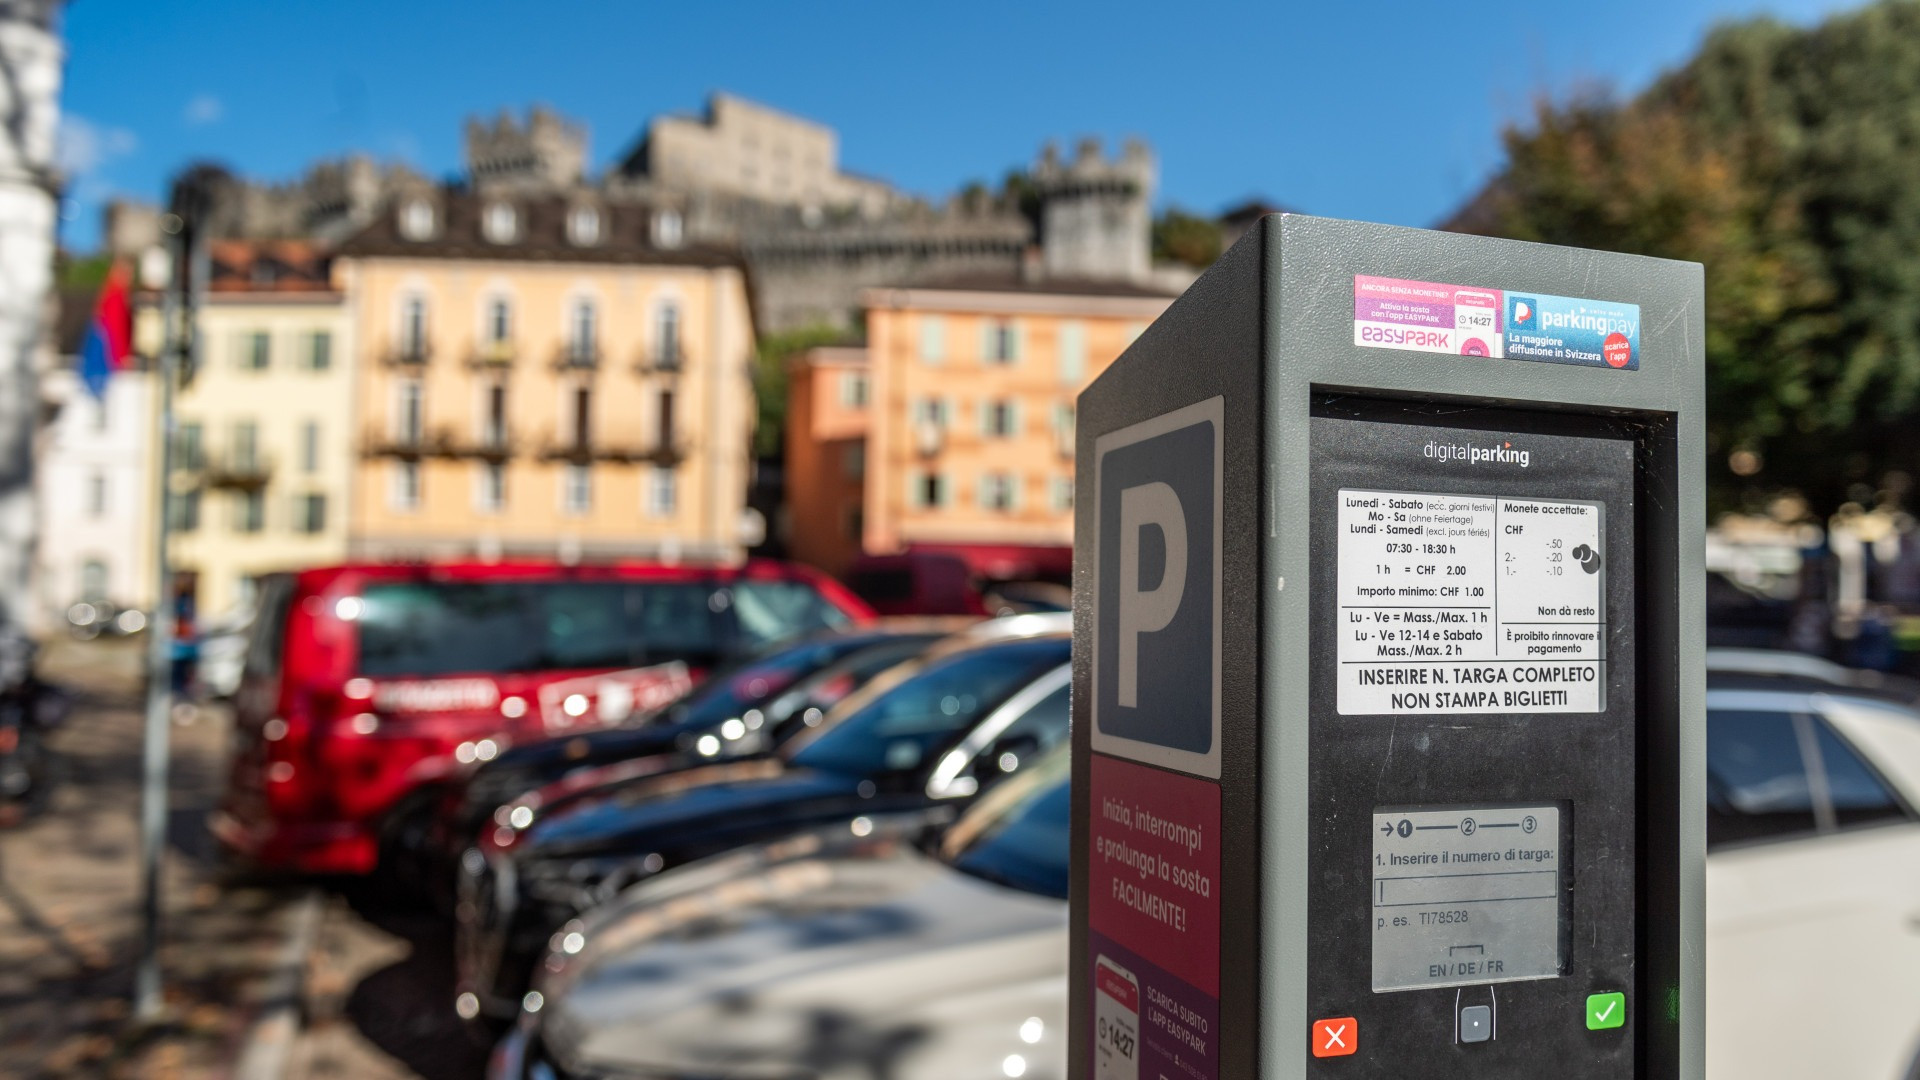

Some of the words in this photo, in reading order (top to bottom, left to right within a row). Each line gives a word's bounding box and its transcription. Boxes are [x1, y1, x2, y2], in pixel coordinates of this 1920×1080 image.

[1361, 284, 1390, 292] ANCORA
[1391, 286, 1412, 294] SENZA
[1380, 302, 1402, 311] Attiva
[1402, 304, 1410, 312] la
[1410, 306, 1430, 314] sosta
[1404, 314, 1440, 322] EASYPARK
[1468, 316, 1492, 326] 14:27
[1542, 308, 1636, 338] parkingpay
[1509, 332, 1520, 342] La
[1522, 335, 1562, 346] maggiore
[1604, 341, 1628, 350] scarica
[1509, 343, 1553, 356] diffusione
[1555, 347, 1563, 358] in
[1565, 349, 1601, 360] Svizzera
[1610, 352, 1626, 362] l'app
[1424, 441, 1529, 467] digitalparking
[1346, 497, 1378, 508] Lunedi
[1388, 499, 1423, 510] Sabato
[1426, 502, 1446, 512] (ecc.
[1449, 502, 1470, 512] giorni
[1472, 502, 1494, 513] festivi)
[1503, 503, 1539, 514] Monete
[1541, 503, 1588, 516] accettate:
[1368, 511, 1384, 521] Mo
[1394, 512, 1406, 522] Sa
[1409, 513, 1432, 524] (ohne
[1434, 514, 1474, 526] Feiertage)
[1350, 523, 1376, 534] Lundi
[1386, 525, 1423, 535] Samedi
[1426, 527, 1446, 537] (excl.
[1448, 528, 1466, 538] jours
[1467, 528, 1490, 538] fériés)
[1505, 525, 1524, 536] CHF
[1386, 543, 1412, 554] 07:30
[1422, 544, 1447, 554] 18:30
[1450, 544, 1456, 554] h
[1545, 539, 1562, 549] -.50
[1546, 552, 1562, 563] -.20
[1376, 564, 1380, 574] 1
[1384, 564, 1390, 574] h
[1416, 565, 1436, 575] CHF
[1446, 566, 1466, 576] 2.00
[1546, 566, 1562, 576] -.10
[1118, 481, 1188, 708] P
[1357, 586, 1396, 598] Importo
[1398, 586, 1437, 596] minimo:
[1440, 586, 1460, 597] CHF
[1465, 587, 1484, 597] 1.00
[1350, 611, 1362, 623] Lu
[1374, 612, 1390, 623] Ve
[1403, 612, 1468, 624] Mass./Max.
[1471, 612, 1476, 623] 1
[1480, 611, 1488, 623] h
[1538, 606, 1556, 616] Non
[1559, 605, 1572, 616] dà
[1573, 606, 1594, 616] resto
[1355, 630, 1368, 641] Lu
[1379, 630, 1395, 641] Ve
[1399, 630, 1430, 641] 12-14
[1433, 632, 1440, 641] e
[1444, 630, 1483, 641] Sabato
[1507, 628, 1512, 640] È
[1514, 630, 1550, 644] proibito
[1551, 630, 1594, 641] rinnovare
[1377, 644, 1442, 658] Mass./Max.
[1445, 645, 1452, 656] 2
[1455, 644, 1462, 656] h
[1527, 643, 1582, 656] pagamento
[1358, 669, 1428, 685] INSERIRE
[1432, 668, 1448, 684] N.
[1453, 667, 1508, 684] TARGA
[1512, 666, 1596, 682] COMPLETO
[1391, 692, 1430, 709] NON
[1435, 691, 1500, 708] STAMPA
[1504, 690, 1568, 706] BIGLIETTI
[1103, 796, 1133, 831] Inizia,
[1135, 805, 1202, 856] interrompi
[1375, 854, 1386, 866] 1.
[1390, 852, 1438, 866] Inserire
[1442, 851, 1448, 864] il
[1452, 852, 1500, 864] numero
[1504, 849, 1516, 861] di
[1519, 849, 1554, 862] targa:
[1097, 835, 1103, 853] e
[1104, 838, 1155, 879] prolunga
[1158, 855, 1170, 881] la
[1172, 863, 1210, 898] sosta
[1112, 877, 1186, 932] FACILMENTE!
[1377, 917, 1388, 929] p.
[1392, 916, 1410, 926] es.
[1419, 910, 1468, 925] TI78528
[1429, 965, 1446, 977] EN
[1458, 962, 1476, 976] DE
[1487, 960, 1504, 974] FR
[1147, 985, 1178, 1018] SCARICA
[1179, 1008, 1208, 1034] SUBITO
[1148, 1006, 1166, 1030] L'APP
[1167, 1018, 1206, 1056] EASYPARK
[1109, 1024, 1134, 1060] 14:27
